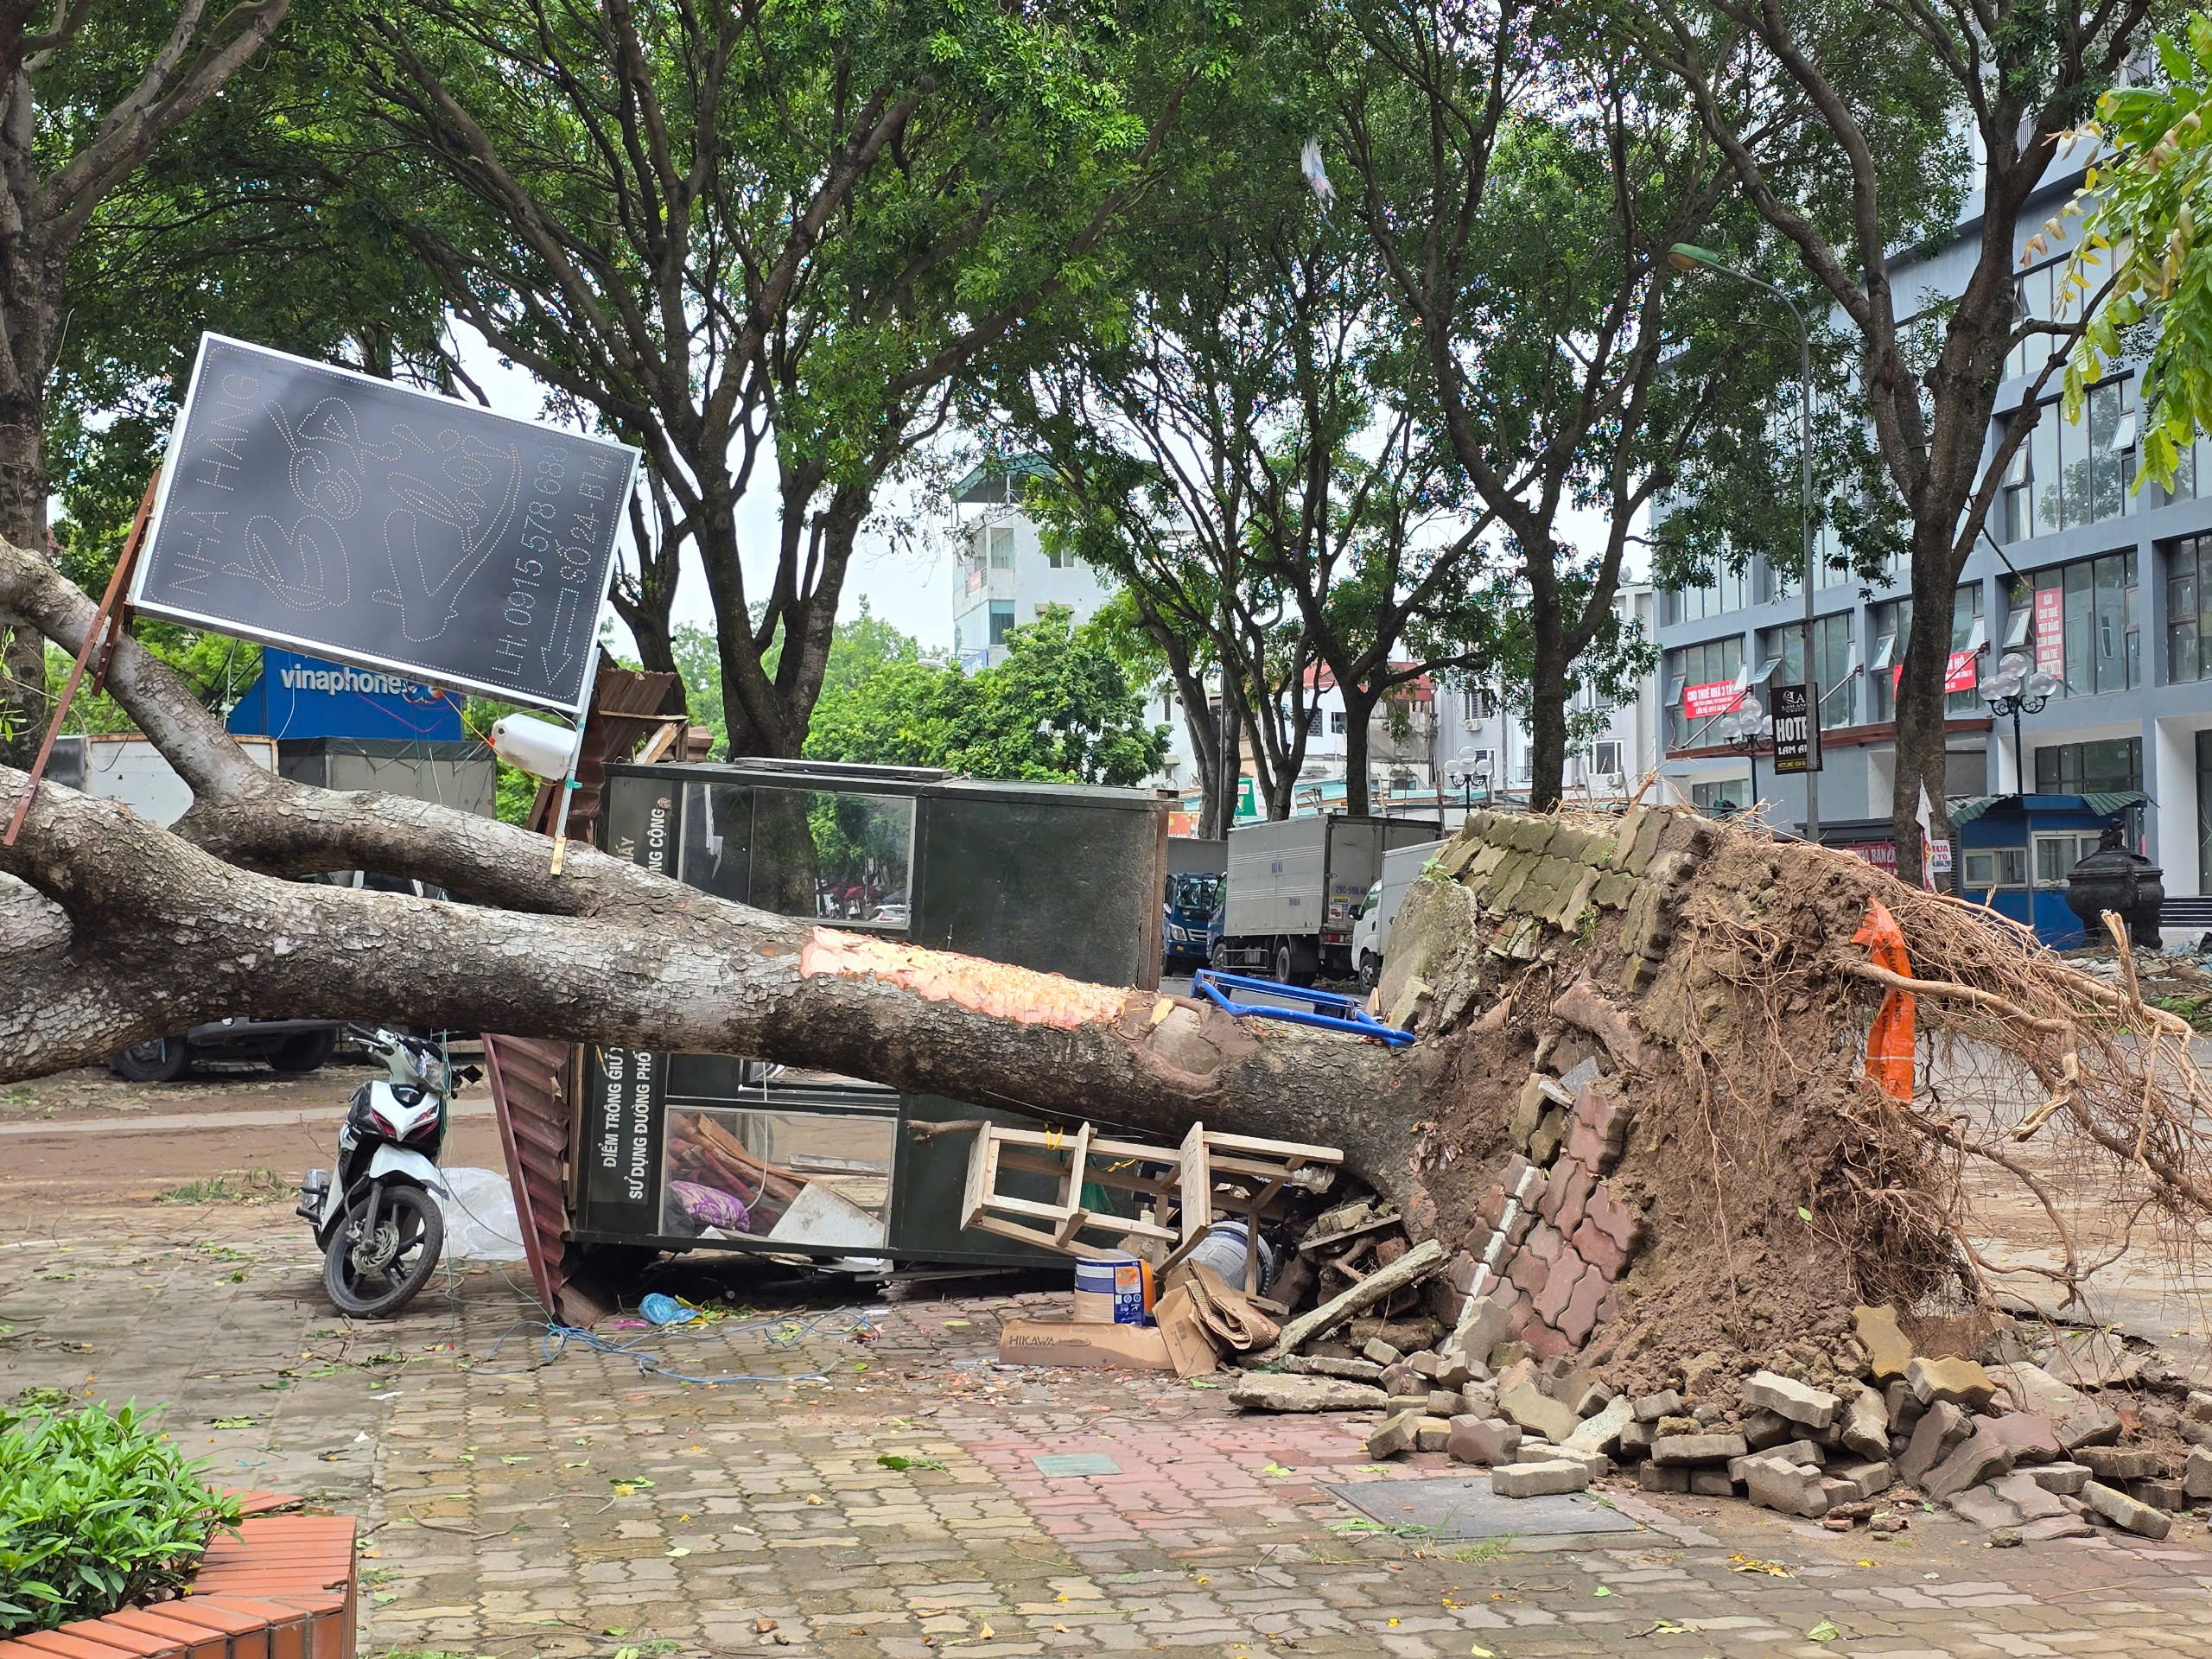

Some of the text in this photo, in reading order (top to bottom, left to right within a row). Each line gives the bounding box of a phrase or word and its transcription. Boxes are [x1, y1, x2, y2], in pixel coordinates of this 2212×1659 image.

[168, 373, 260, 596] NHÀ HÀNG
[533, 444, 567, 495] 688
[520, 501, 556, 552] 578
[504, 558, 543, 626] 0915
[281, 664, 404, 696] vinaphone
[1776, 716, 1807, 742] HOTE
[624, 808, 667, 1200] SỬ DỤNG ĐƯỜNG PHỐ NG CỘNG
[605, 1052, 624, 1080] GIỮ
[604, 1083, 622, 1130] TRÔNG
[598, 1134, 619, 1168] ĐIỂM
[1008, 1335, 1055, 1347] HIKAWA
